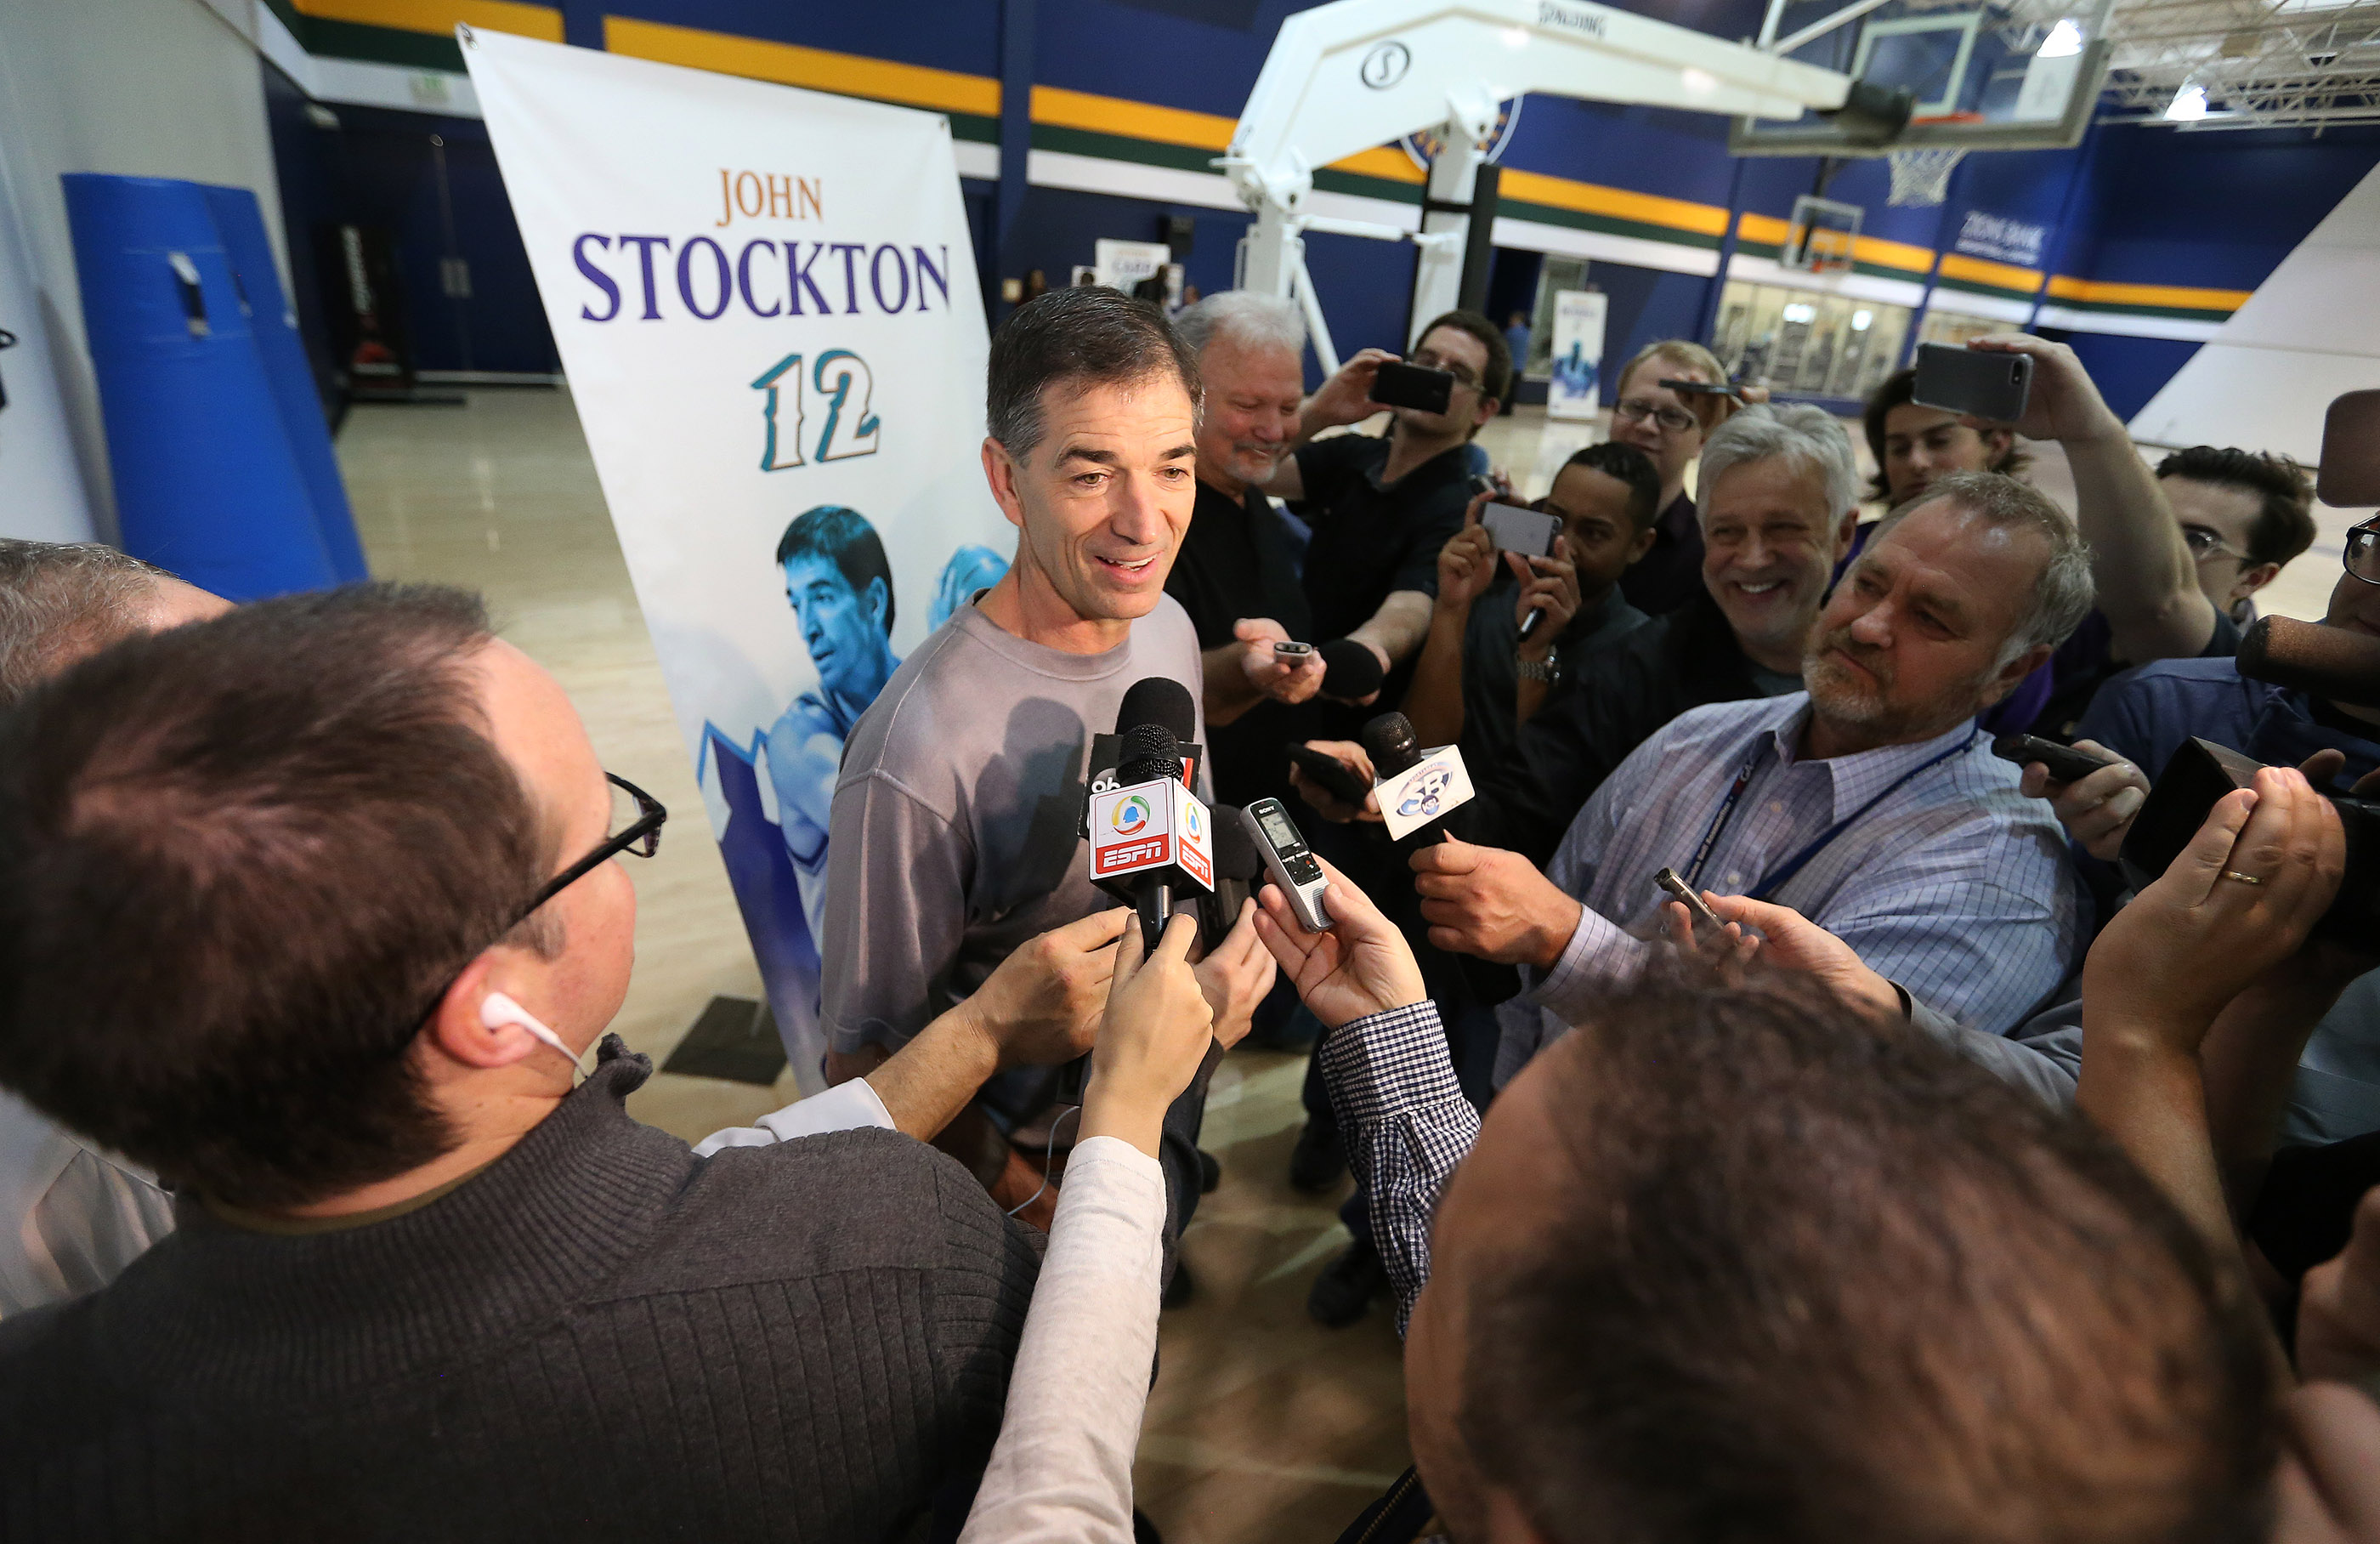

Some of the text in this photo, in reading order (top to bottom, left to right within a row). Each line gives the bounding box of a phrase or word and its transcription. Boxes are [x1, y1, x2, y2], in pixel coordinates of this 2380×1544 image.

[715, 167, 824, 229] JOHN
[572, 233, 950, 322] STOCKTON
[749, 347, 881, 473] 12
[1258, 805, 1275, 815] SONY
[1102, 841, 1163, 868] ESPN
[1182, 843, 1209, 879] ESPN
